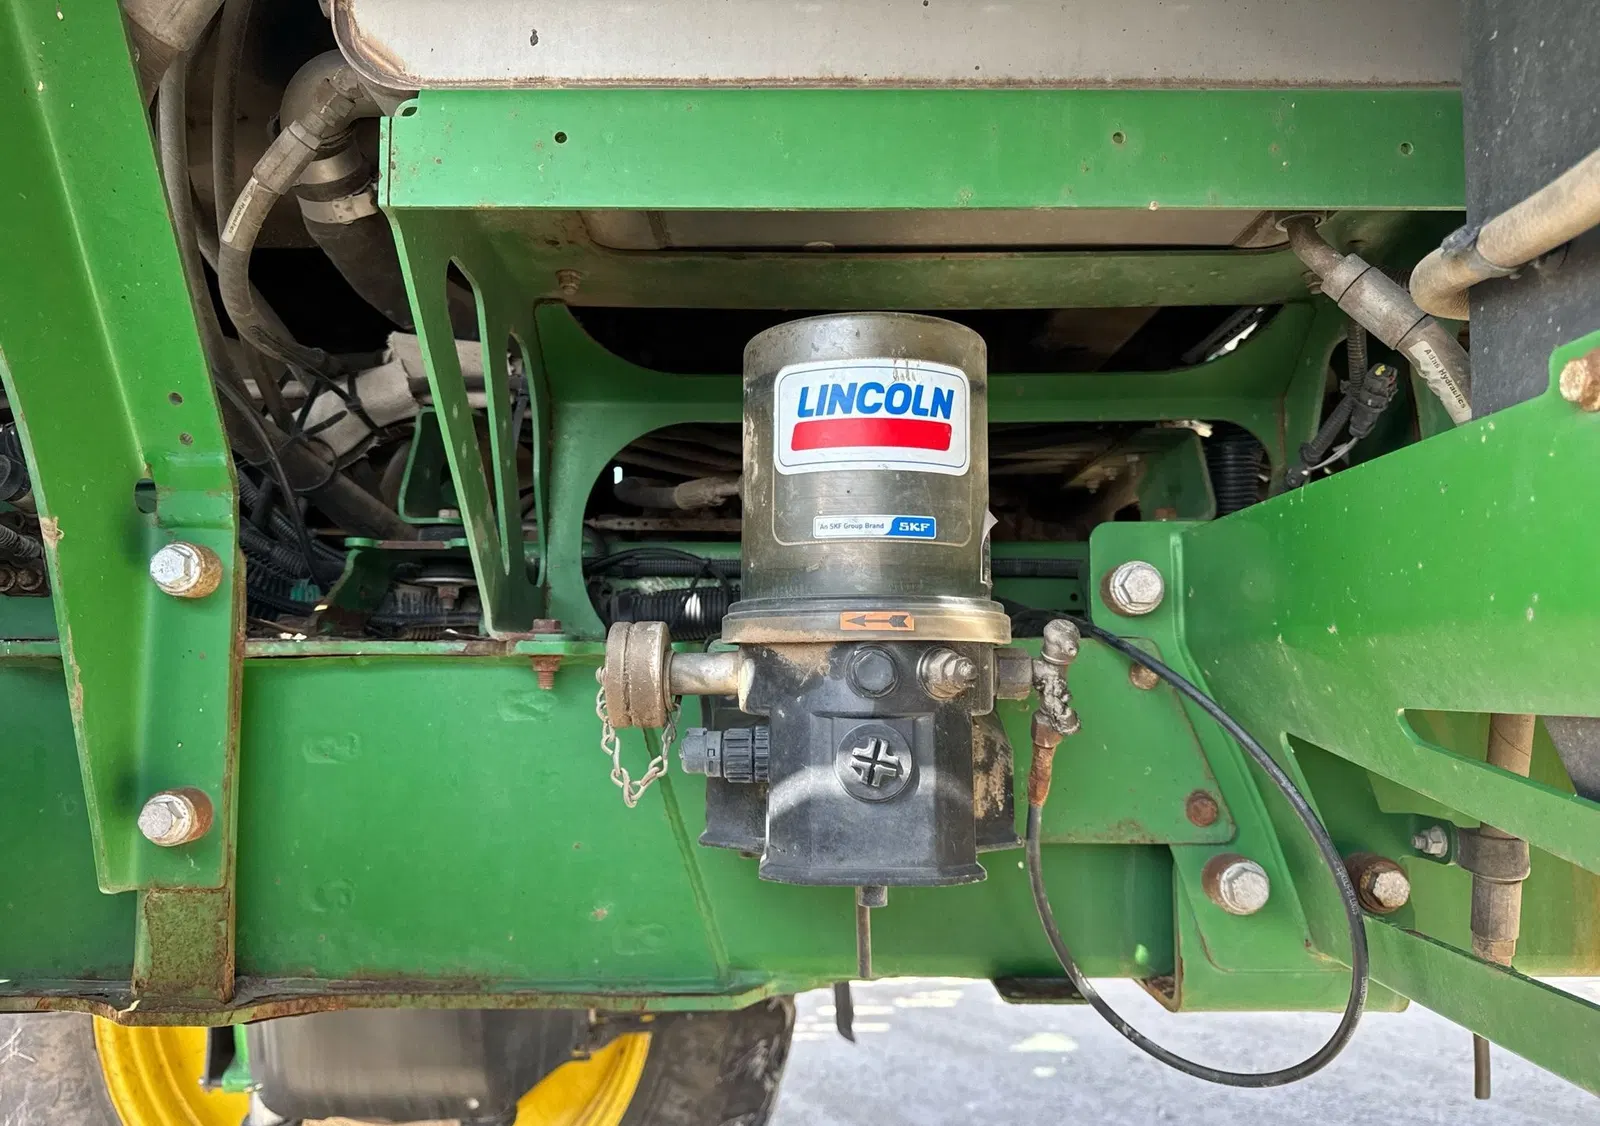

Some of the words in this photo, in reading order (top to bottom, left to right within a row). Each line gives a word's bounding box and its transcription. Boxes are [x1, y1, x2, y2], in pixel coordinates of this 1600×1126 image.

[1438, 368, 1467, 409] Hydraulics
[797, 382, 955, 420] LINCOLN
[829, 522, 842, 530] SKF
[843, 522, 863, 530] Group
[898, 521, 931, 532] SKF
